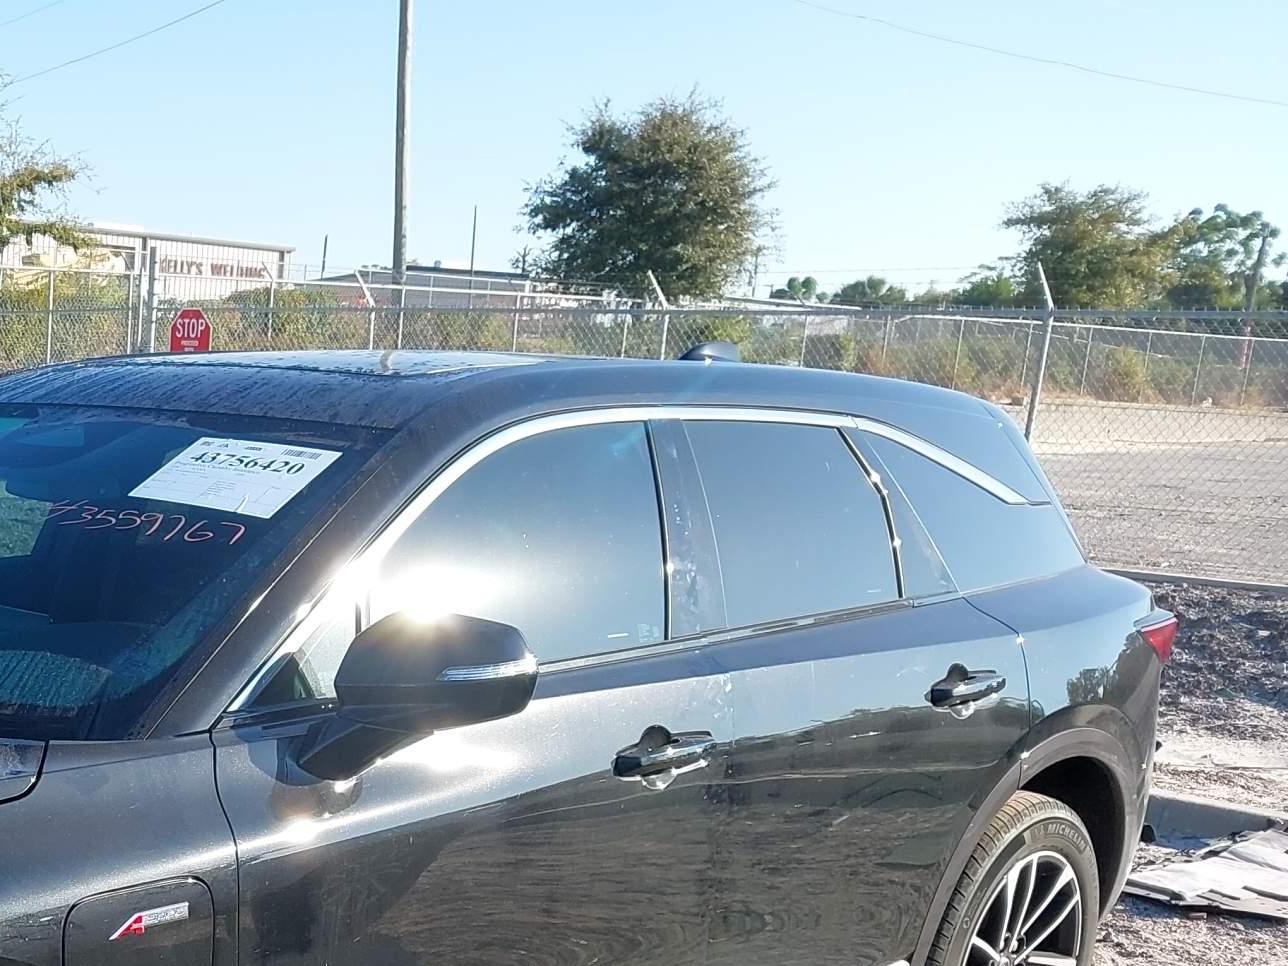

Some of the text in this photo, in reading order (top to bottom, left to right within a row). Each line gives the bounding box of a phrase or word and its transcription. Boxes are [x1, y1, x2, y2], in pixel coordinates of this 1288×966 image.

[175, 318, 206, 338] STOP
[189, 451, 305, 476] 43756420
[1047, 823, 1087, 851] MICHELIN
